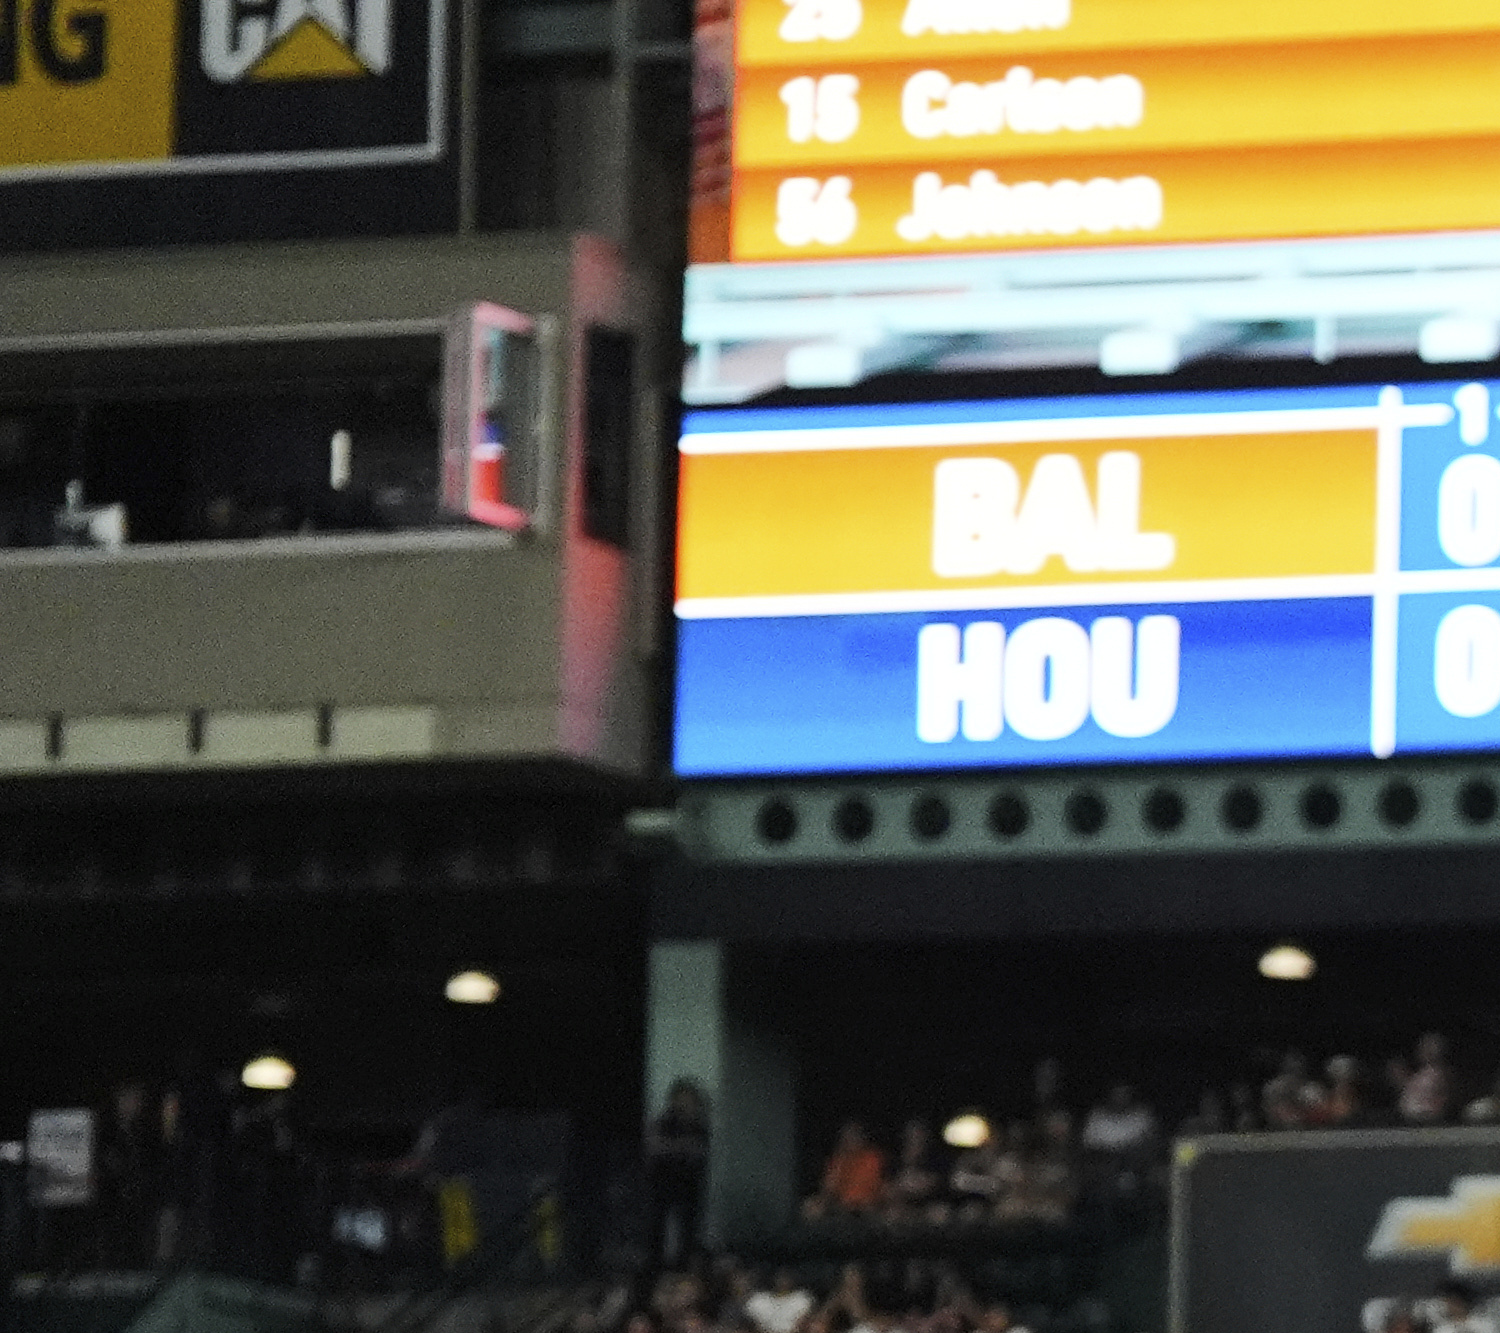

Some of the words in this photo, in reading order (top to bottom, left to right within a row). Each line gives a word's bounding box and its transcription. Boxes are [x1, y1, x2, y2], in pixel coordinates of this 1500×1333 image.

[780, 72, 860, 143] 15
[1454, 384, 1490, 445] 1
[931, 450, 1176, 578] BAL
[917, 613, 1180, 744] HOU
